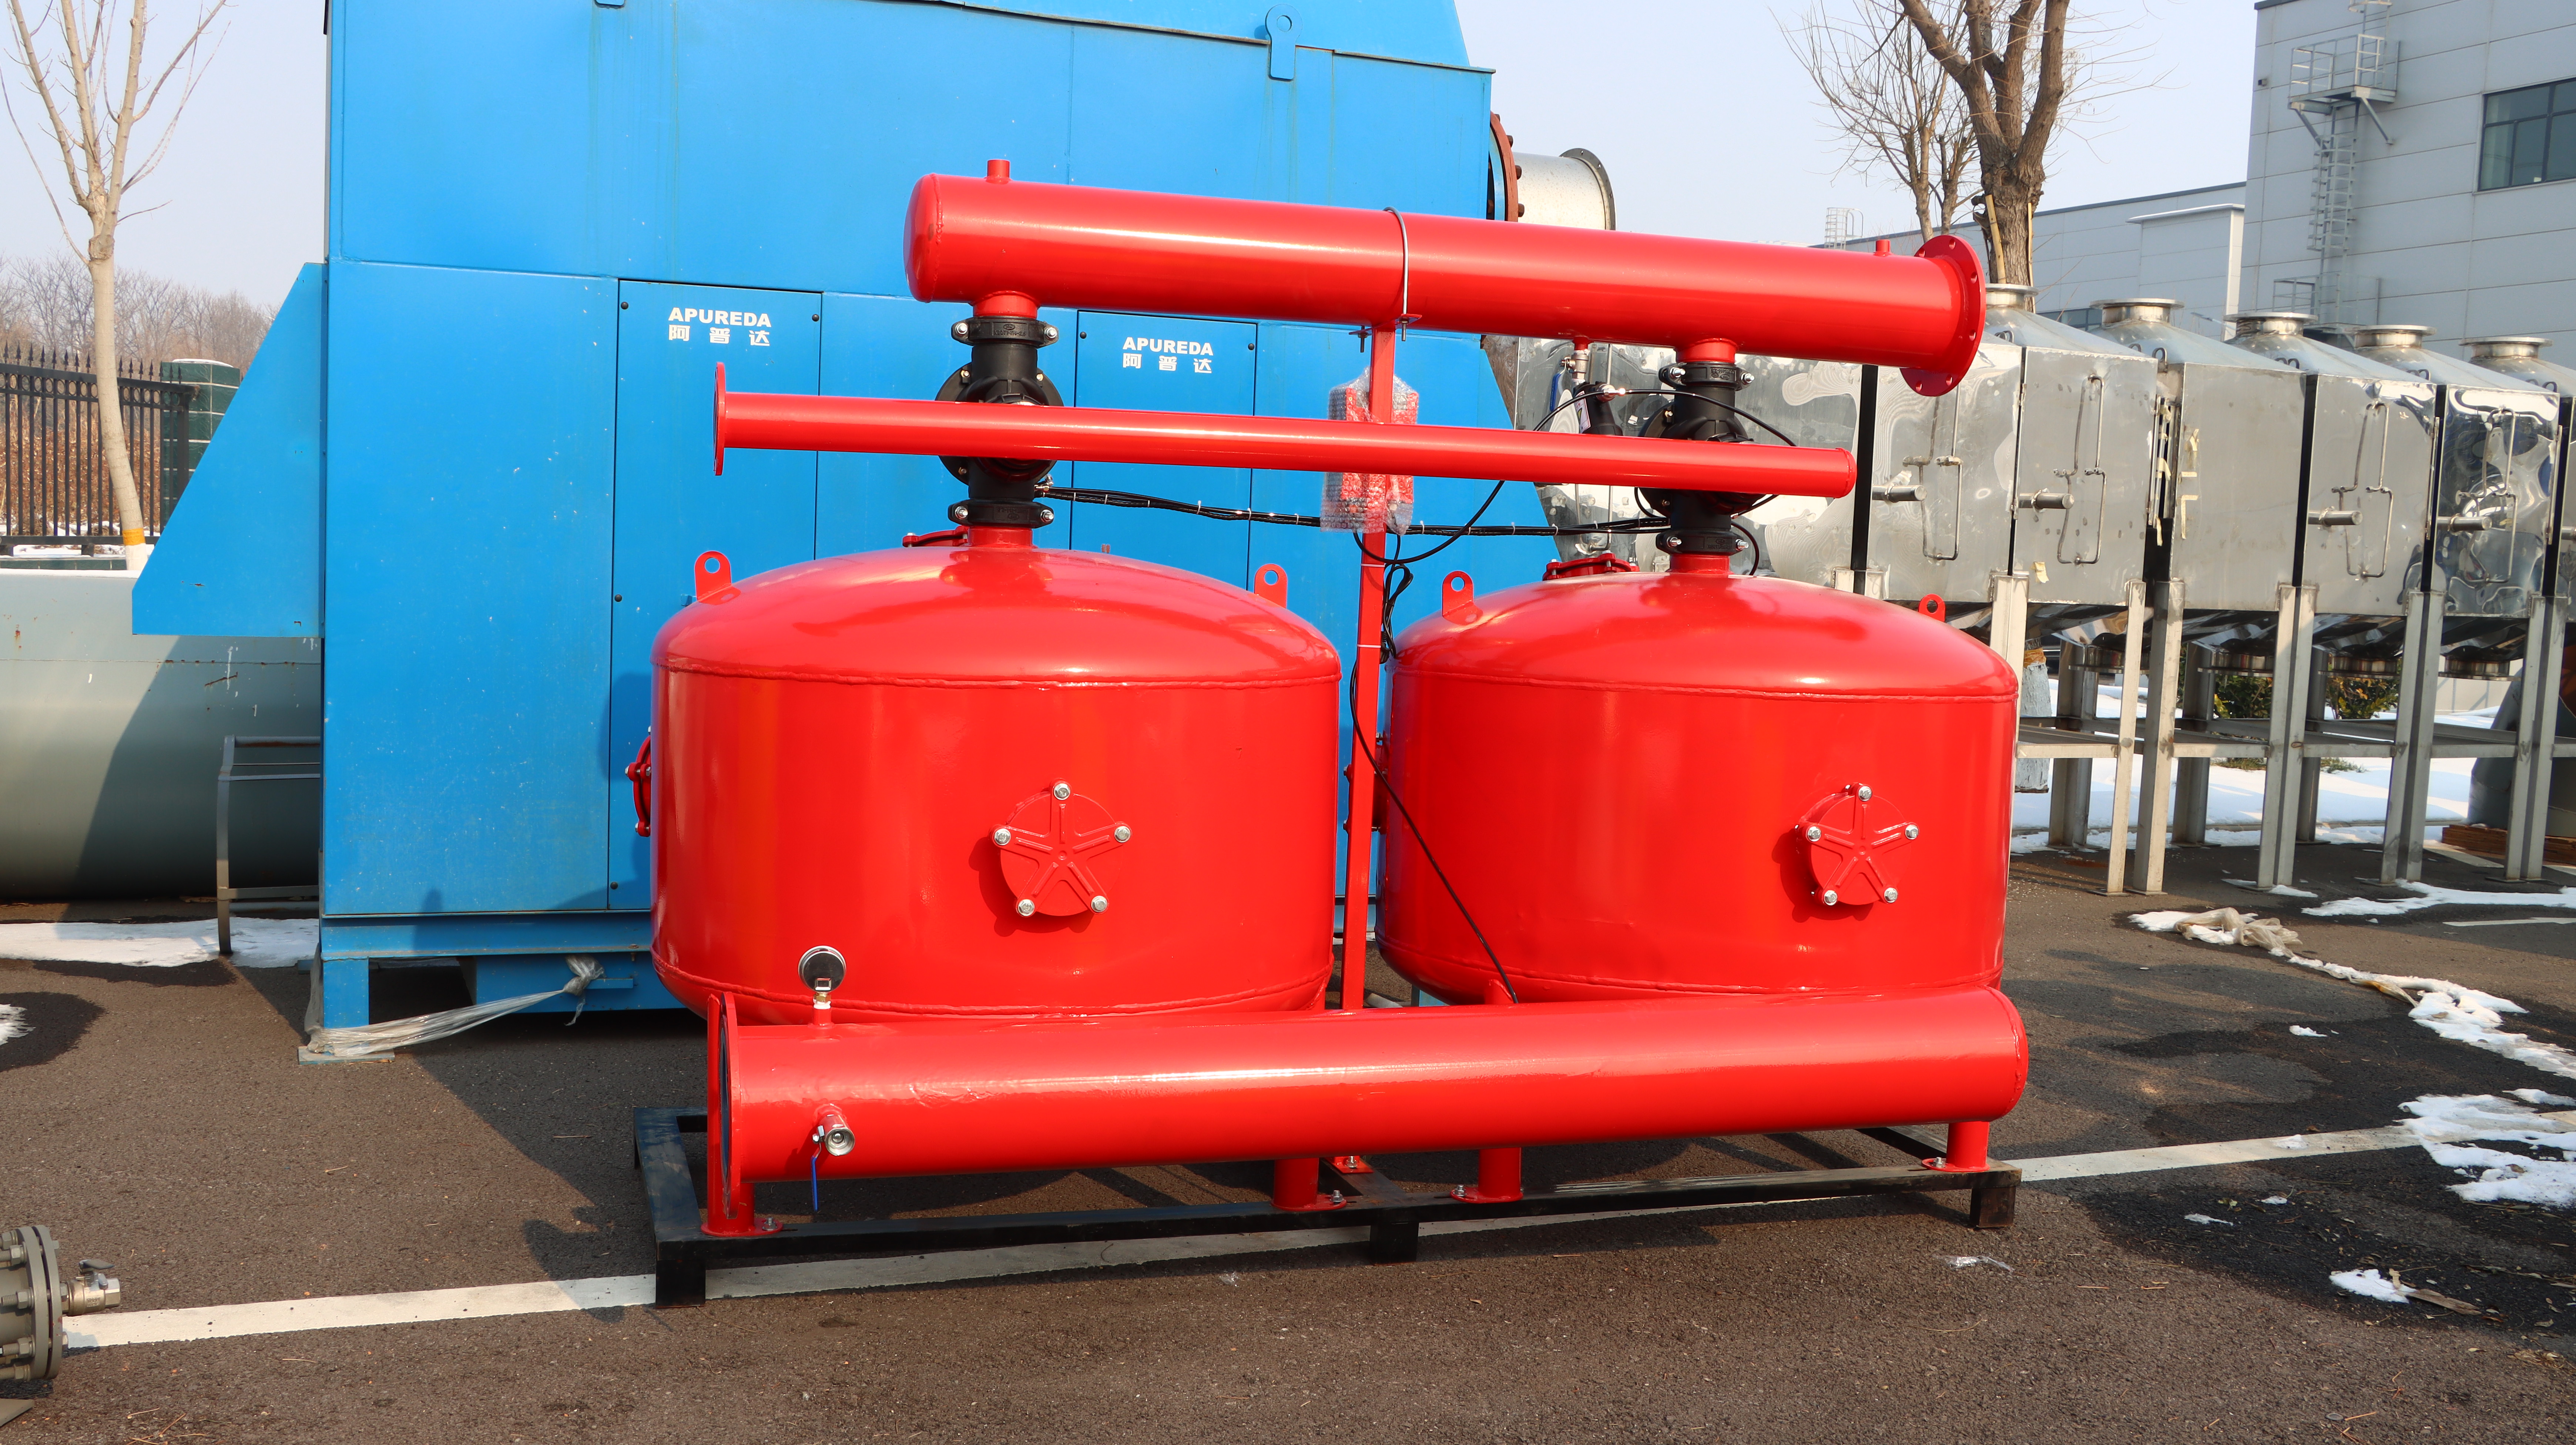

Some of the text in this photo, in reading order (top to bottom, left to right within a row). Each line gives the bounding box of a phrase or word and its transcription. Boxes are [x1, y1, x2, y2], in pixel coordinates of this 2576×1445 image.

[668, 307, 772, 328] APUREDA
[668, 324, 770, 346] 阿普达
[1122, 336, 1214, 356] APUREDA
[1123, 352, 1212, 373] 阿普达
